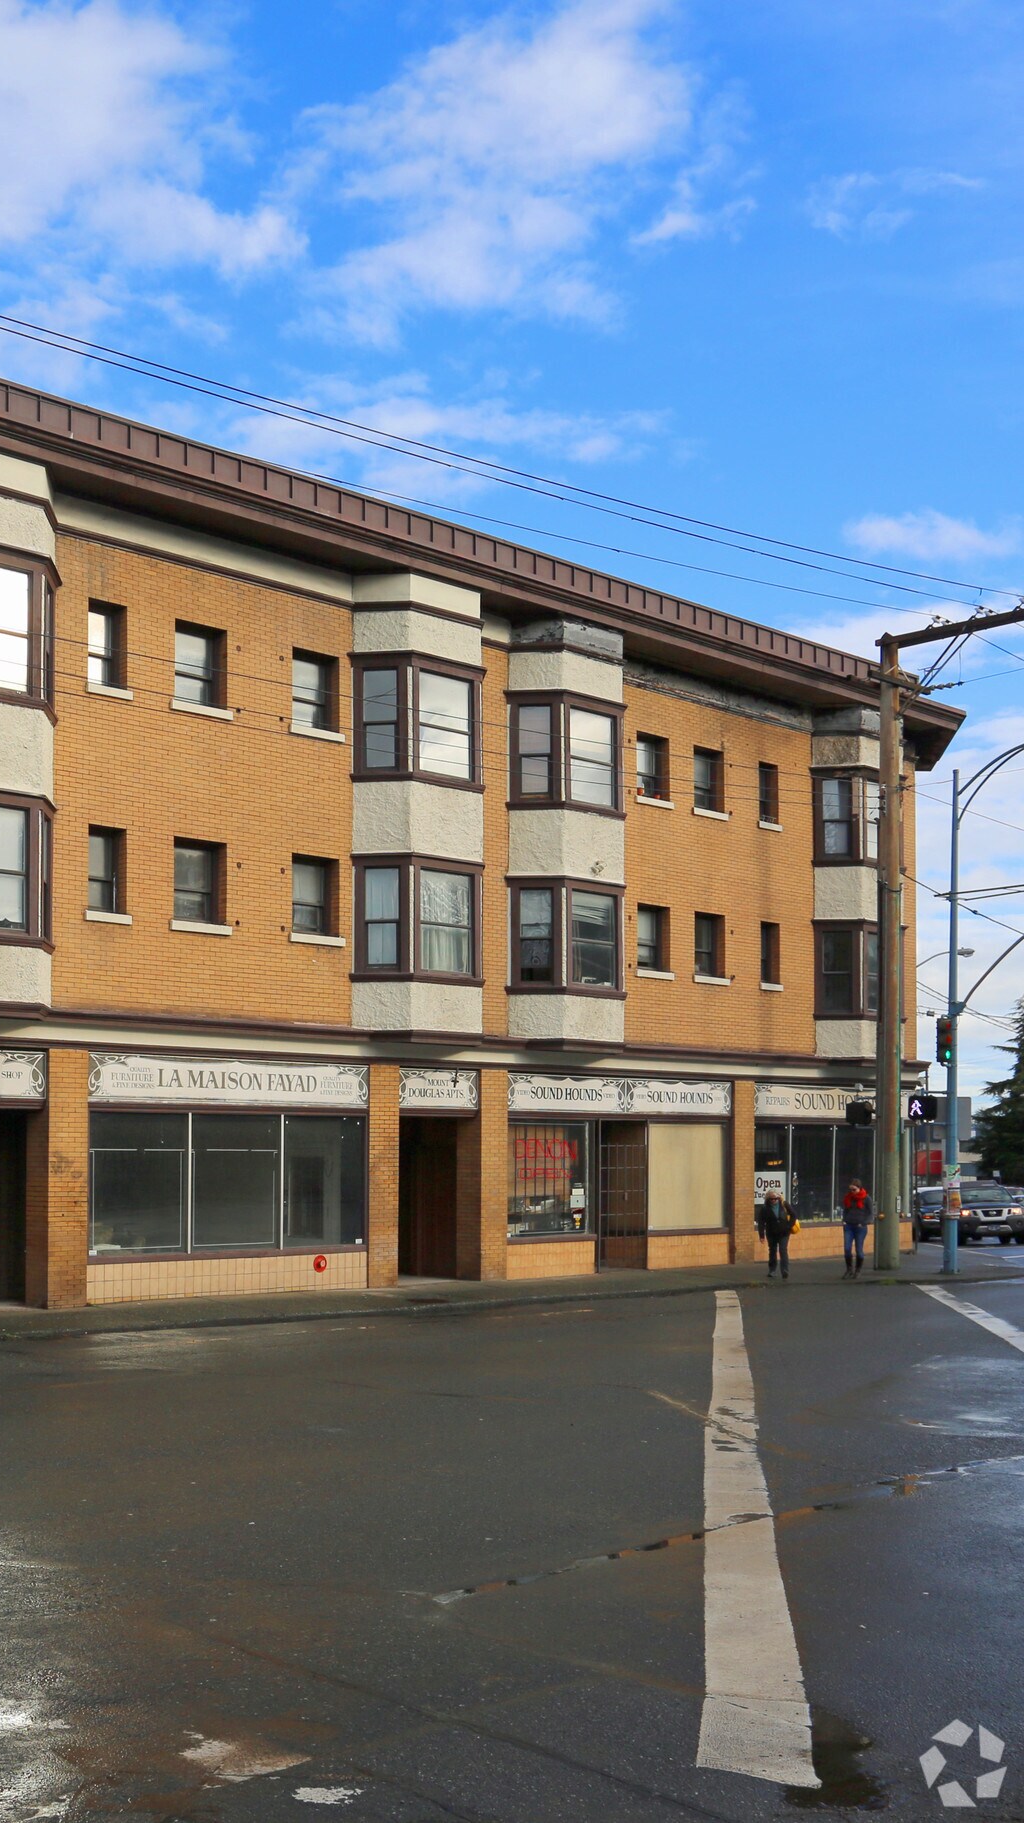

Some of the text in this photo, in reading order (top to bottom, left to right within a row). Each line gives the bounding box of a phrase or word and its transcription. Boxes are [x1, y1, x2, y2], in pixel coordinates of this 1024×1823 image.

[1, 1070, 24, 1080] SHOP
[111, 1072, 154, 1082] FURNITURE
[157, 1068, 317, 1093] LA MAISON FAYAD
[320, 1081, 353, 1090] FURNITURE
[408, 1087, 466, 1099] DOUGLAS APTS.
[530, 1085, 603, 1102] SOUND HOUNDS
[646, 1090, 678, 1104] SOUND
[680, 1091, 713, 1105] HOUNDS
[765, 1096, 791, 1106] REPAIRS
[794, 1092, 835, 1111] SOUND
[514, 1138, 577, 1160] DENON
[519, 1167, 573, 1180] OPEN
[756, 1177, 781, 1191] Open
